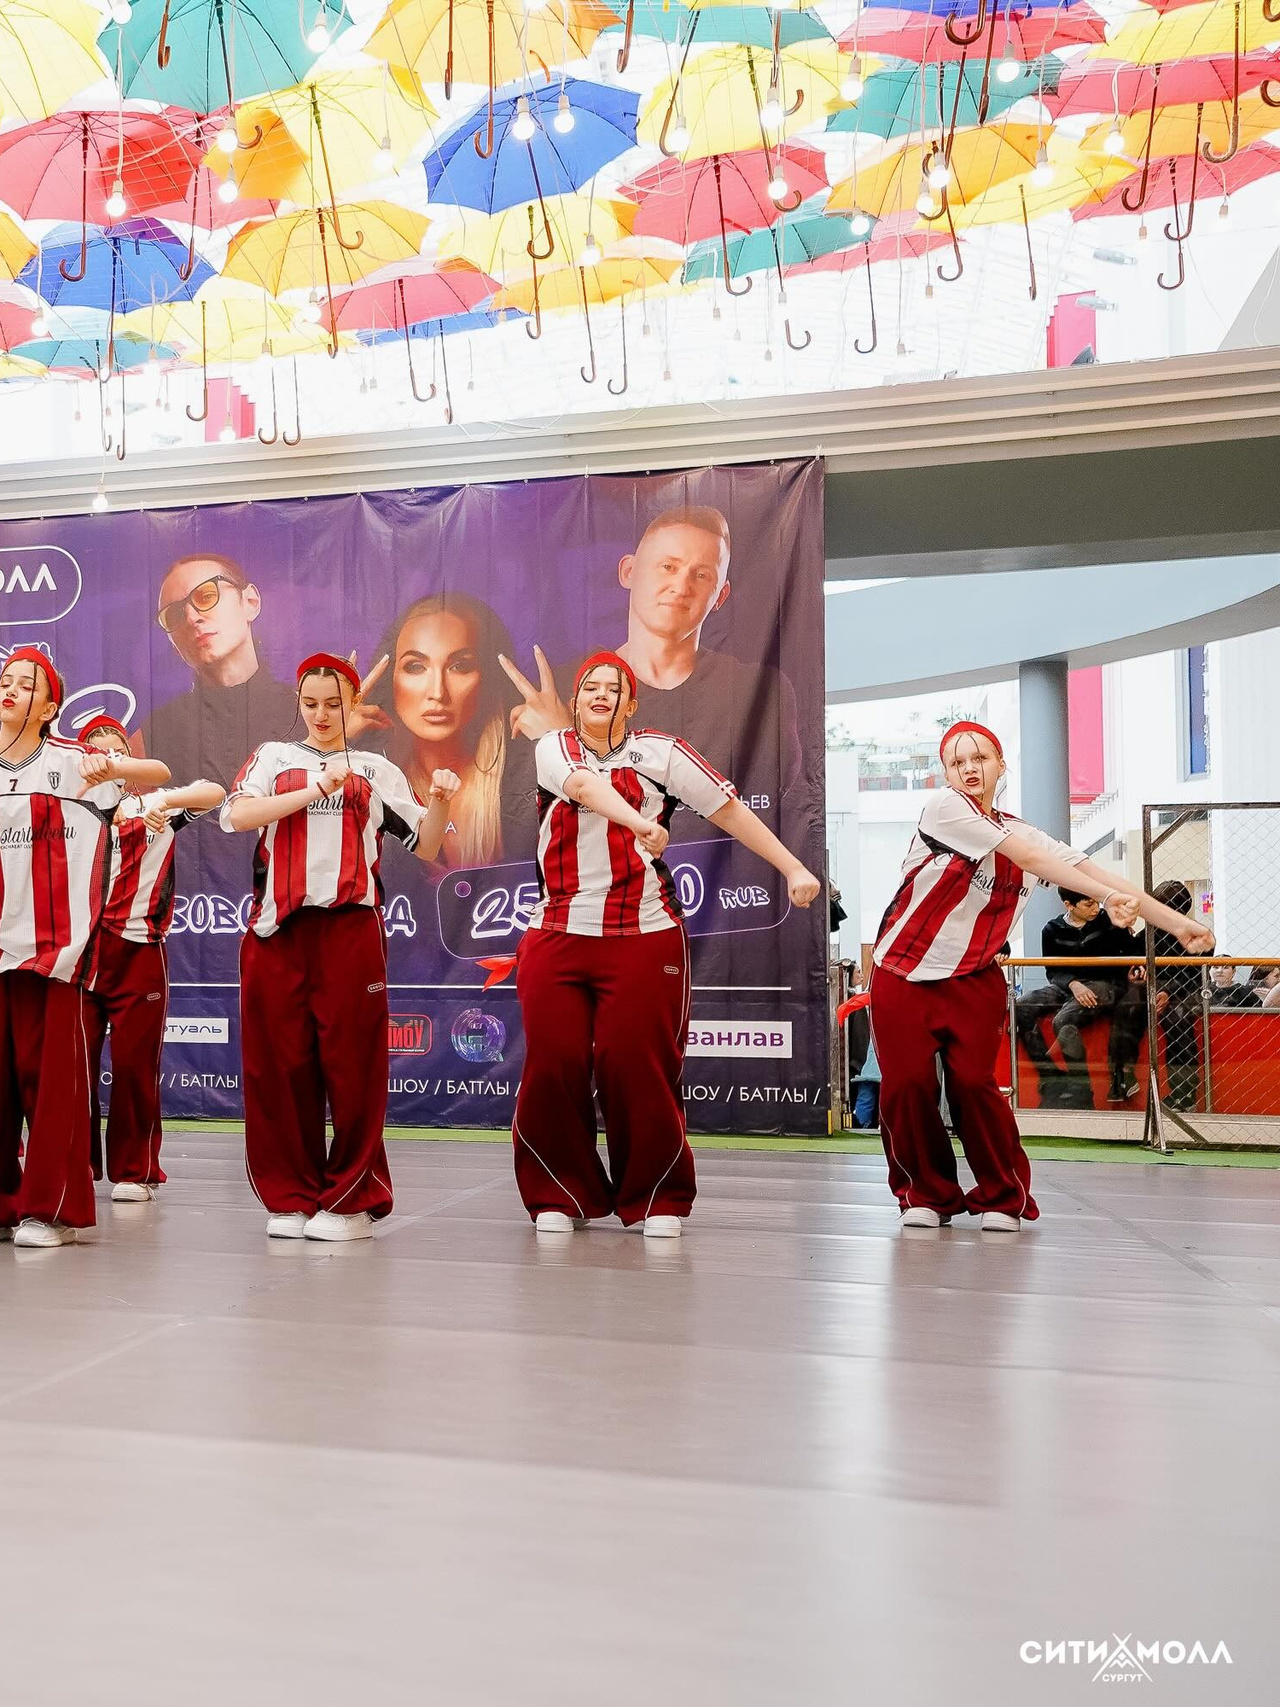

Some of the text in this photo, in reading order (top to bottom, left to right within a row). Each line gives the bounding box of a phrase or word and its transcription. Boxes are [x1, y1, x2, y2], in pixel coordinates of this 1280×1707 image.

[9, 778, 19, 792] 7
[719, 886, 770, 909] RUB
[181, 1074, 238, 1088] БАТТЛЫ
[447, 1081, 510, 1095] БАТТЛЫ
[740, 1086, 807, 1103] БАТТЛЫ
